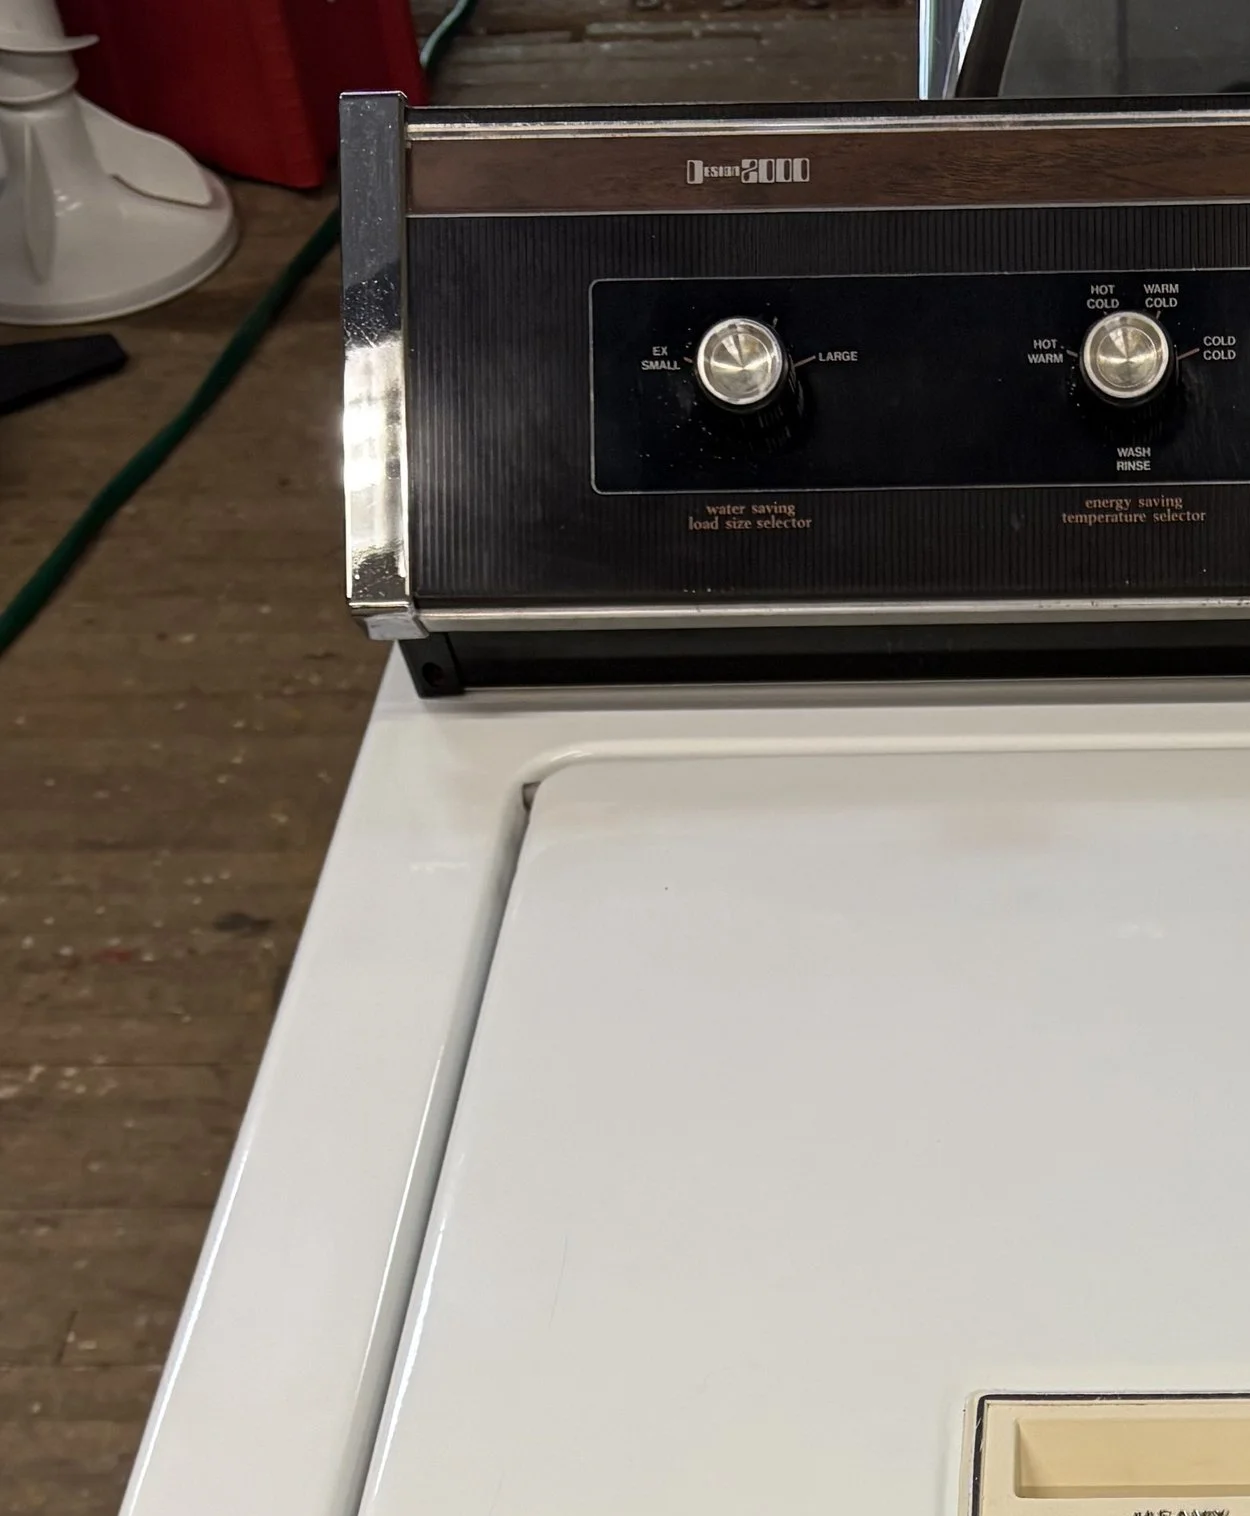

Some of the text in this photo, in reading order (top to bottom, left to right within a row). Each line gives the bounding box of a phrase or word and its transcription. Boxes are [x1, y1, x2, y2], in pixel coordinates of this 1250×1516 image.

[1090, 284, 1116, 295] HOT
[1143, 283, 1180, 294] WARM
[1086, 298, 1120, 309] COLD
[1145, 297, 1178, 308] COLD
[1033, 339, 1058, 350] HOT
[1203, 335, 1237, 346] COLD
[652, 346, 668, 356] EX
[818, 351, 859, 362] LARGE
[1203, 350, 1237, 360] COLD
[1027, 353, 1064, 364] WARM
[641, 360, 681, 371] SMALL
[1116, 446, 1151, 457] WASH
[1116, 460, 1151, 471] RINSE
[1085, 494, 1183, 511] energy saving
[706, 501, 796, 517] water saving
[688, 514, 813, 530] load size selector
[1062, 508, 1207, 526] temperature selector
